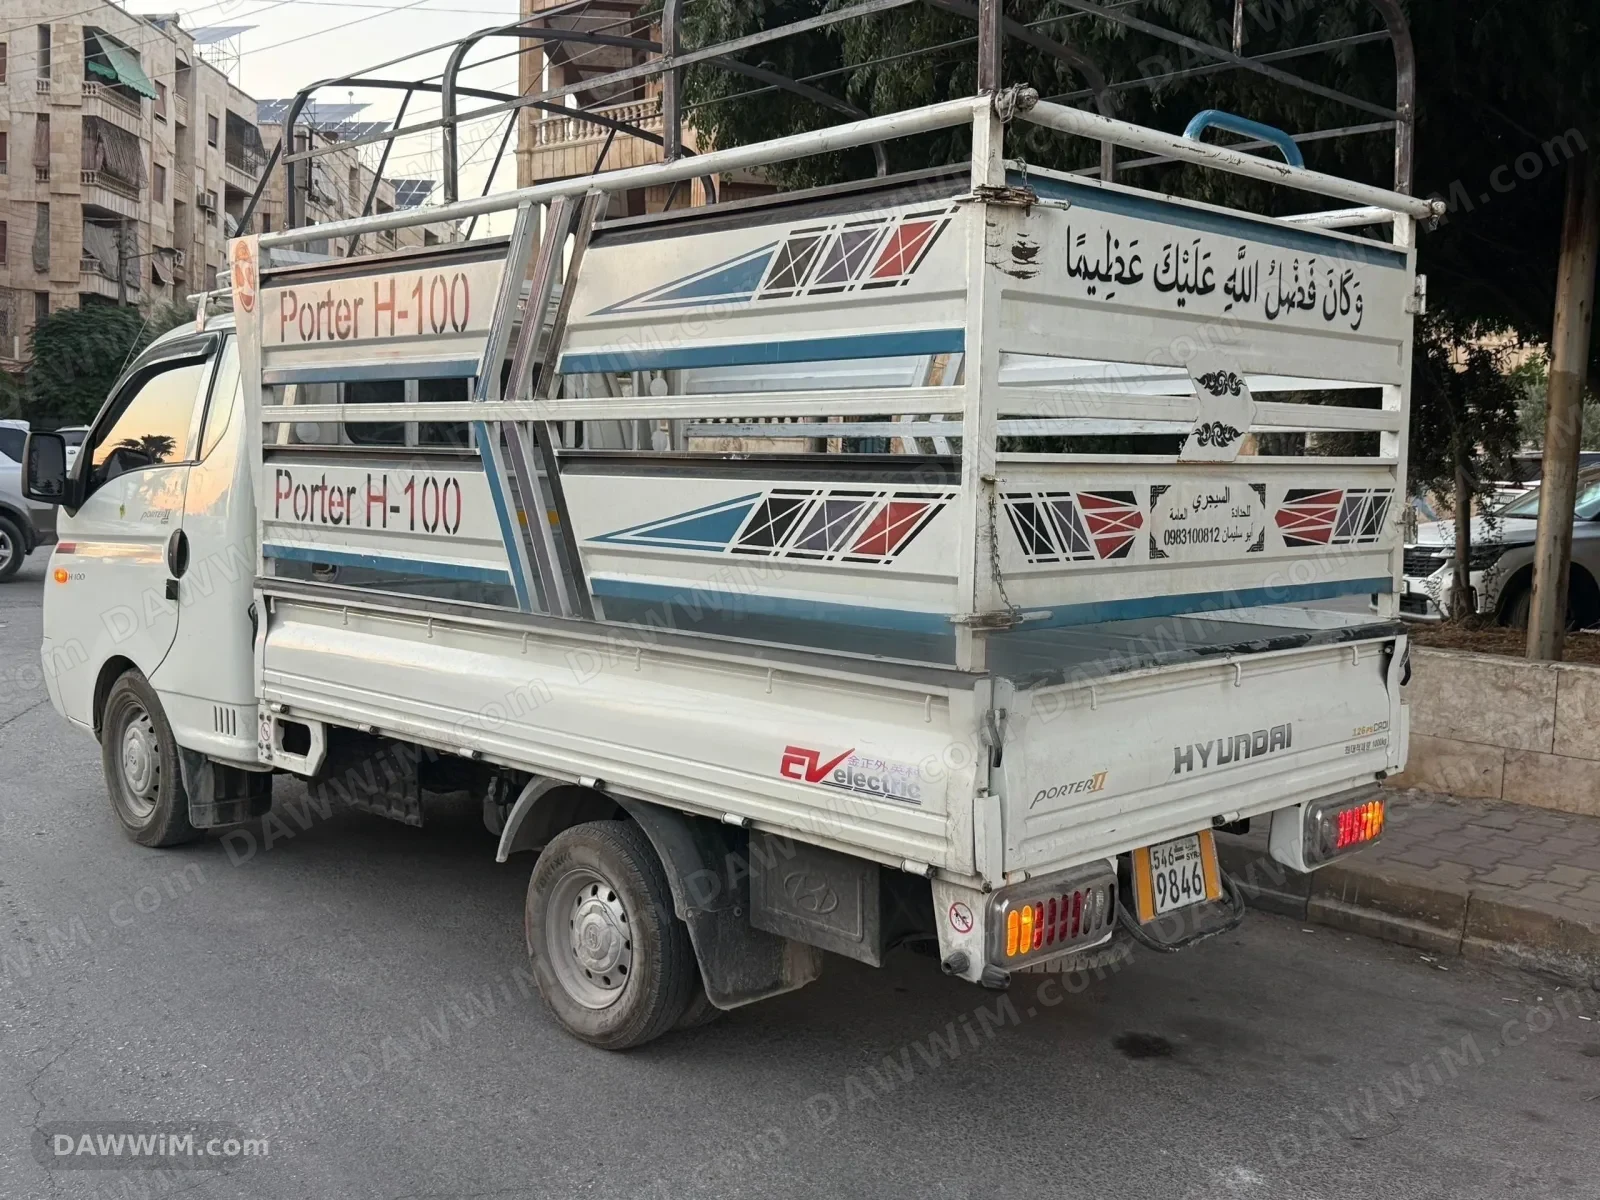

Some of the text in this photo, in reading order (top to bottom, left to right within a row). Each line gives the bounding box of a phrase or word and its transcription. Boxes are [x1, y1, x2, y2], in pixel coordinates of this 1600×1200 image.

[280, 272, 470, 343] Porter H-100
[275, 468, 462, 535] Porter H-100
[1163, 527, 1220, 546] 0983100812
[779, 745, 856, 783] EV
[1173, 722, 1292, 775] HYUNDAI
[833, 765, 922, 799] electric
[1153, 847, 1175, 870] 546
[1156, 861, 1203, 908] 9846
